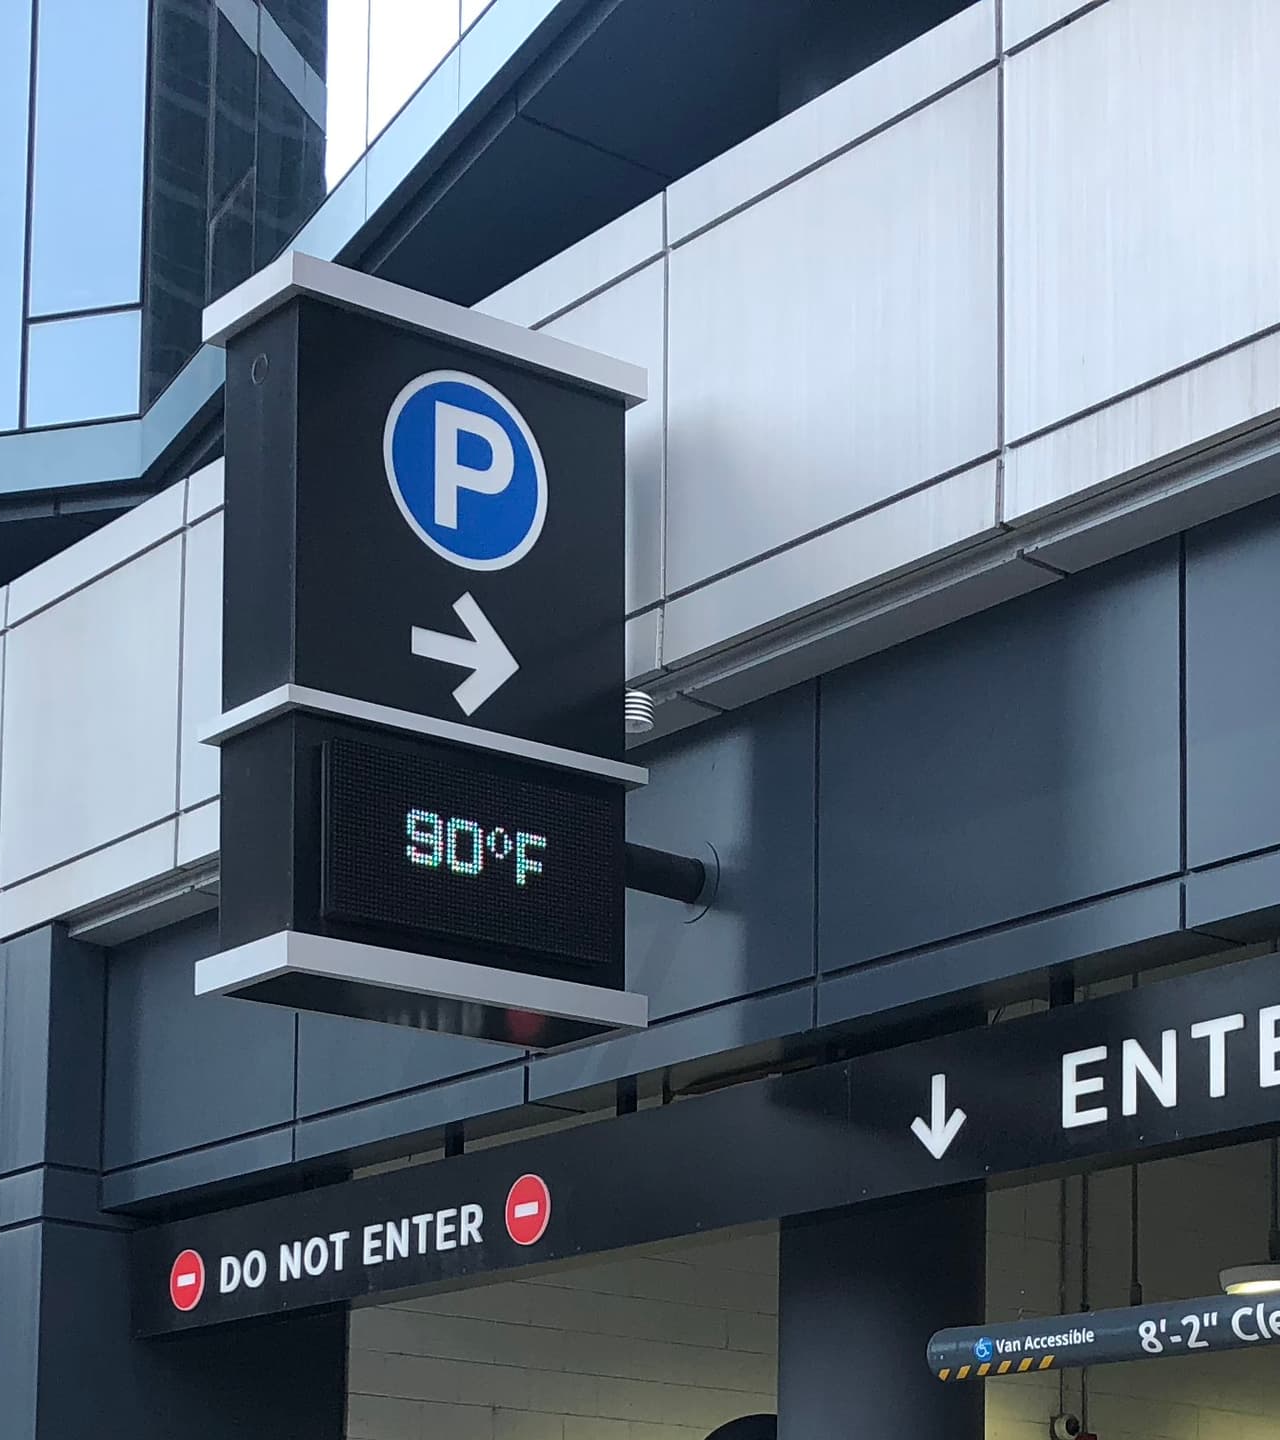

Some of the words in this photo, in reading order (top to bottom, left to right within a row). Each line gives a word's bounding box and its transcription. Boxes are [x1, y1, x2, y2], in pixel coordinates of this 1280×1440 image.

[433, 399, 516, 531] P
[406, 808, 547, 885] 90°F
[220, 1249, 267, 1294] DO
[279, 1230, 350, 1282] NOT
[362, 1203, 485, 1265] ENTER
[995, 1338, 1022, 1354] Van
[1024, 1328, 1095, 1351] Accessible
[1138, 1311, 1218, 1354] 8'-2"
